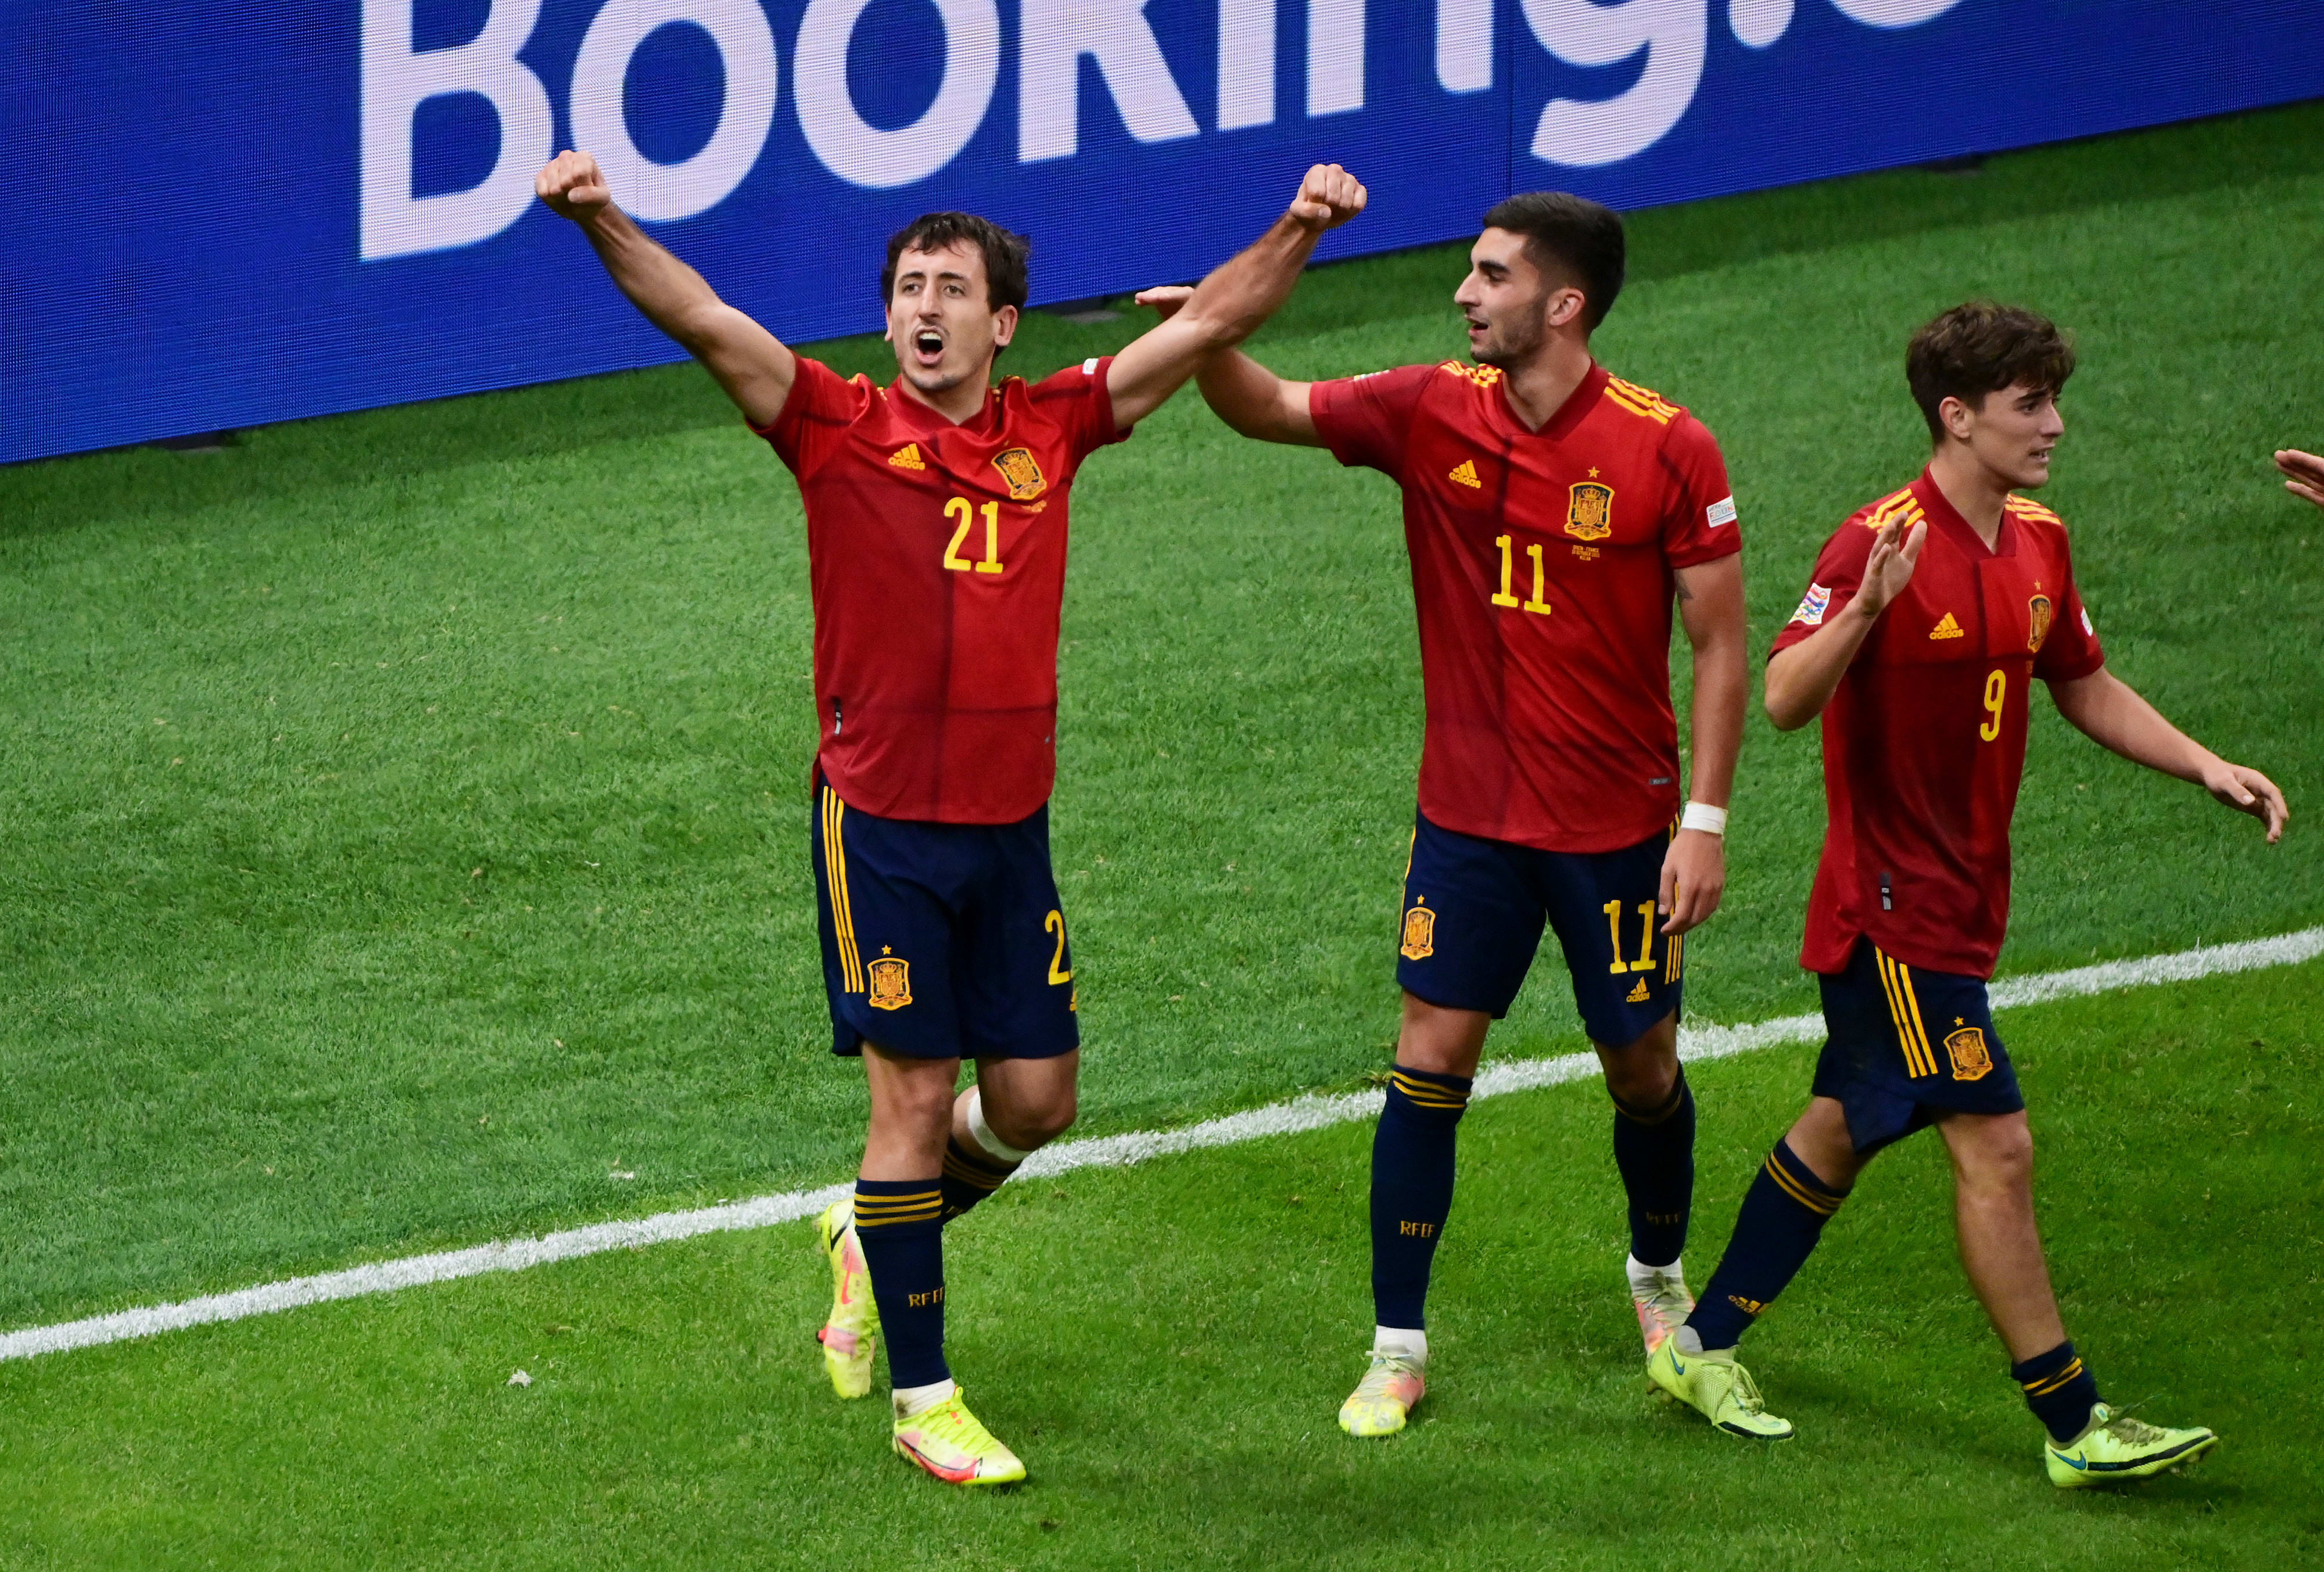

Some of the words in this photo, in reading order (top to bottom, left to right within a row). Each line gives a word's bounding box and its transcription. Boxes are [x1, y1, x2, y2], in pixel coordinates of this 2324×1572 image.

[888, 457, 925, 470] adidas
[1449, 472, 1481, 488] adidas
[944, 497, 1003, 573] 21
[1491, 534, 1551, 615] 11
[1930, 629, 1964, 640] adidas
[1980, 669, 2006, 742] 9
[1045, 909, 1074, 985] 2
[1604, 900, 1656, 974] 11
[1626, 992, 1650, 1002] adidas
[1400, 1220, 1436, 1237] RFEF
